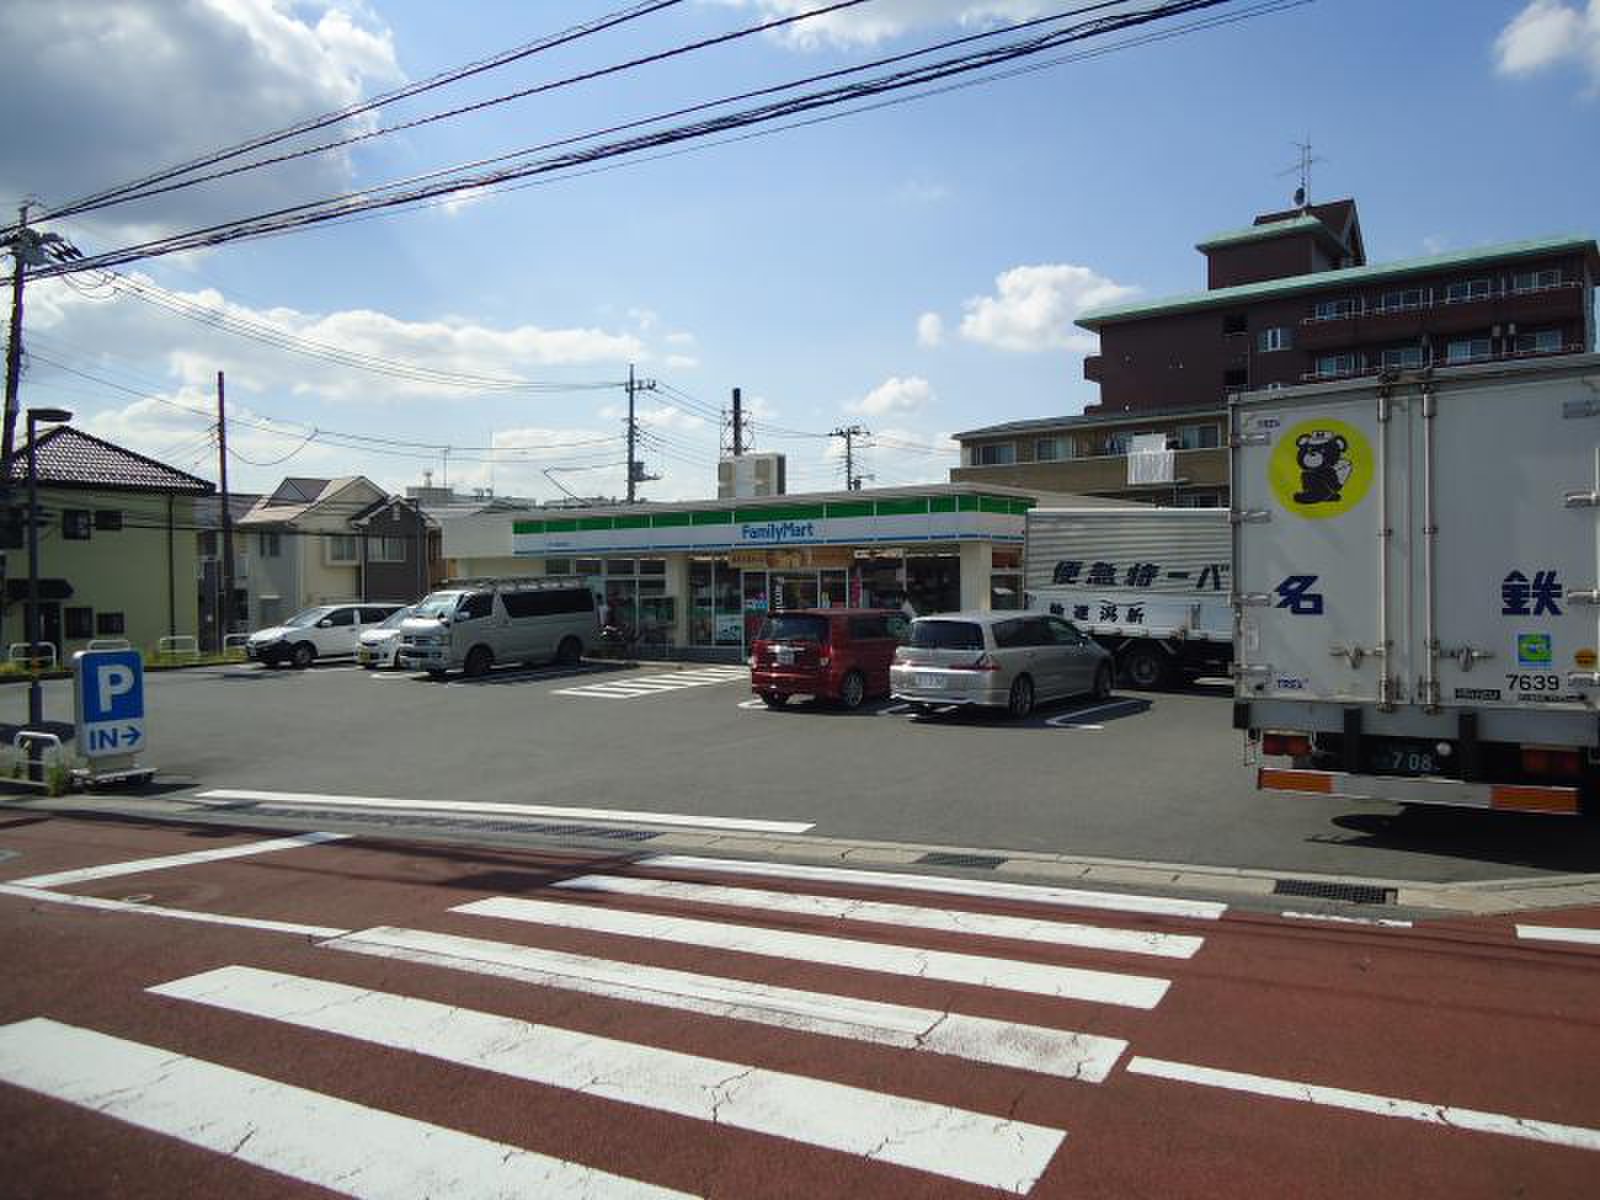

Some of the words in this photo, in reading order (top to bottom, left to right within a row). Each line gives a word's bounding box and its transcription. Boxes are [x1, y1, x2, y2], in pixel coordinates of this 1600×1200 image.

[743, 522, 814, 541] FamilyMart
[1273, 575, 1324, 615] 名
[1501, 570, 1564, 616] 鉄
[97, 664, 135, 712] P
[1506, 675, 1559, 691] 7639
[90, 729, 118, 751] IN
